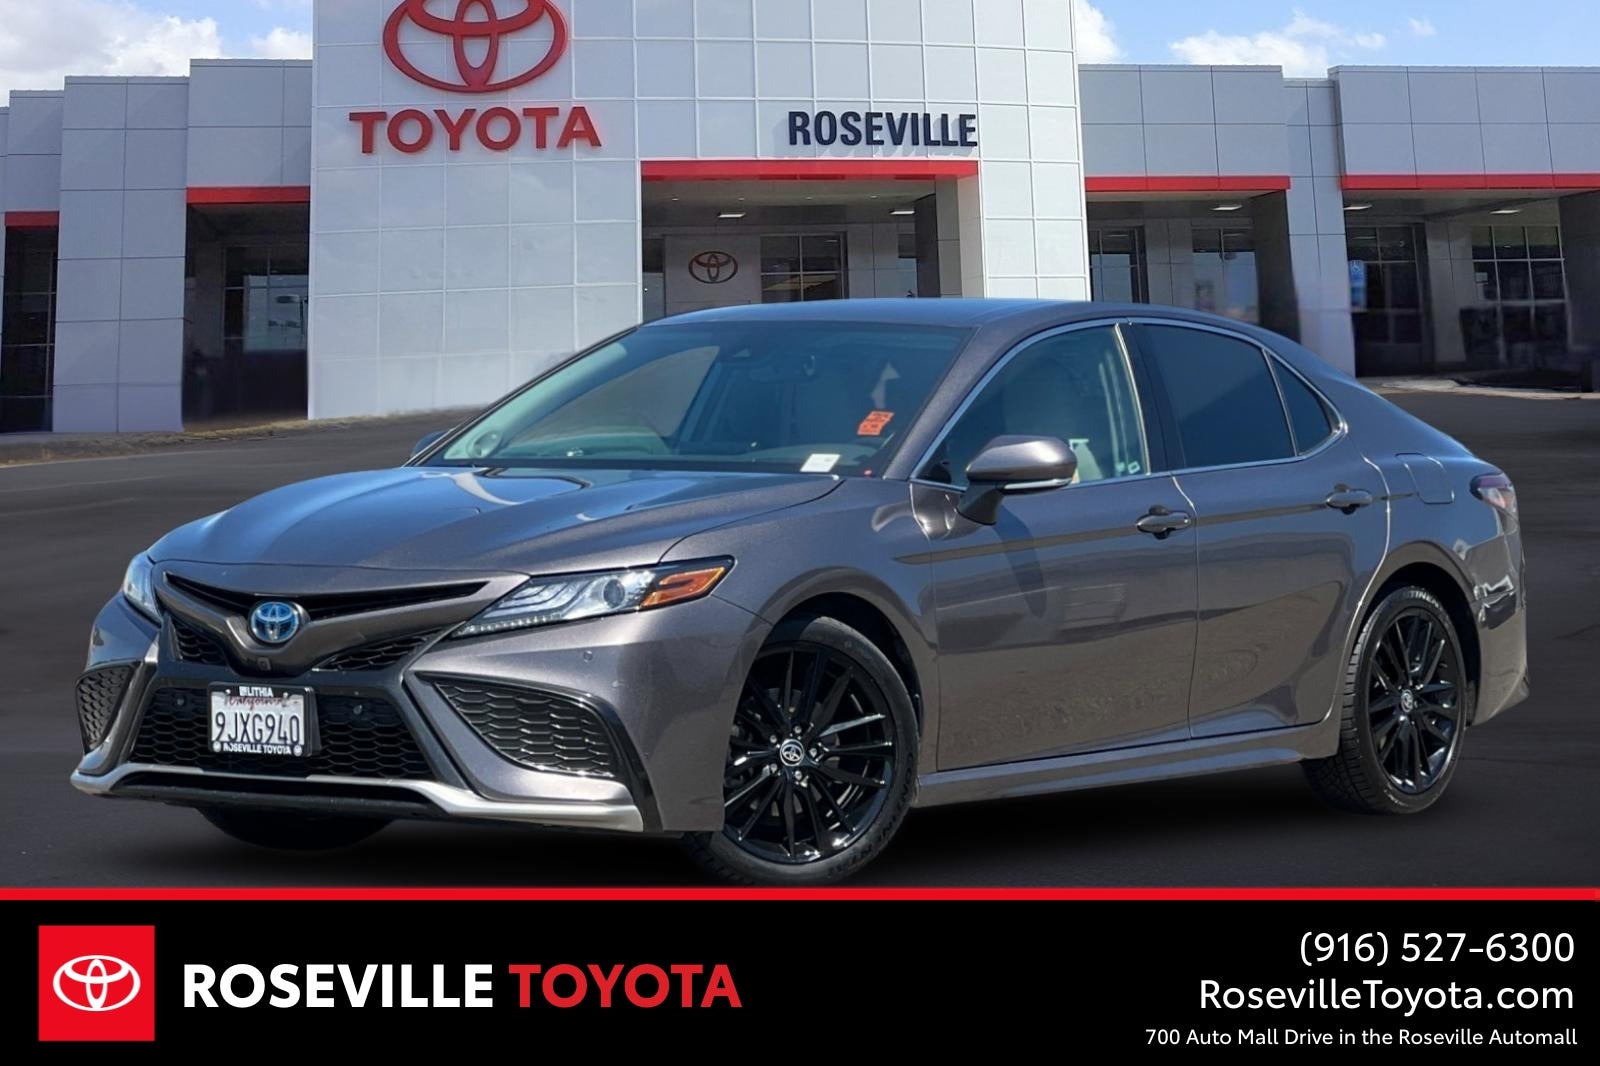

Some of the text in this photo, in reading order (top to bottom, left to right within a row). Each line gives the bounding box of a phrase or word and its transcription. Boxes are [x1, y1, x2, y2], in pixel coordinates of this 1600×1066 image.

[349, 106, 602, 154] TOYOTA
[788, 110, 978, 147] ROSEVILLE
[247, 687, 274, 698] LITHIA
[215, 711, 300, 745] 9JXG940
[223, 743, 292, 755] ROSEVILLE TOYOTA
